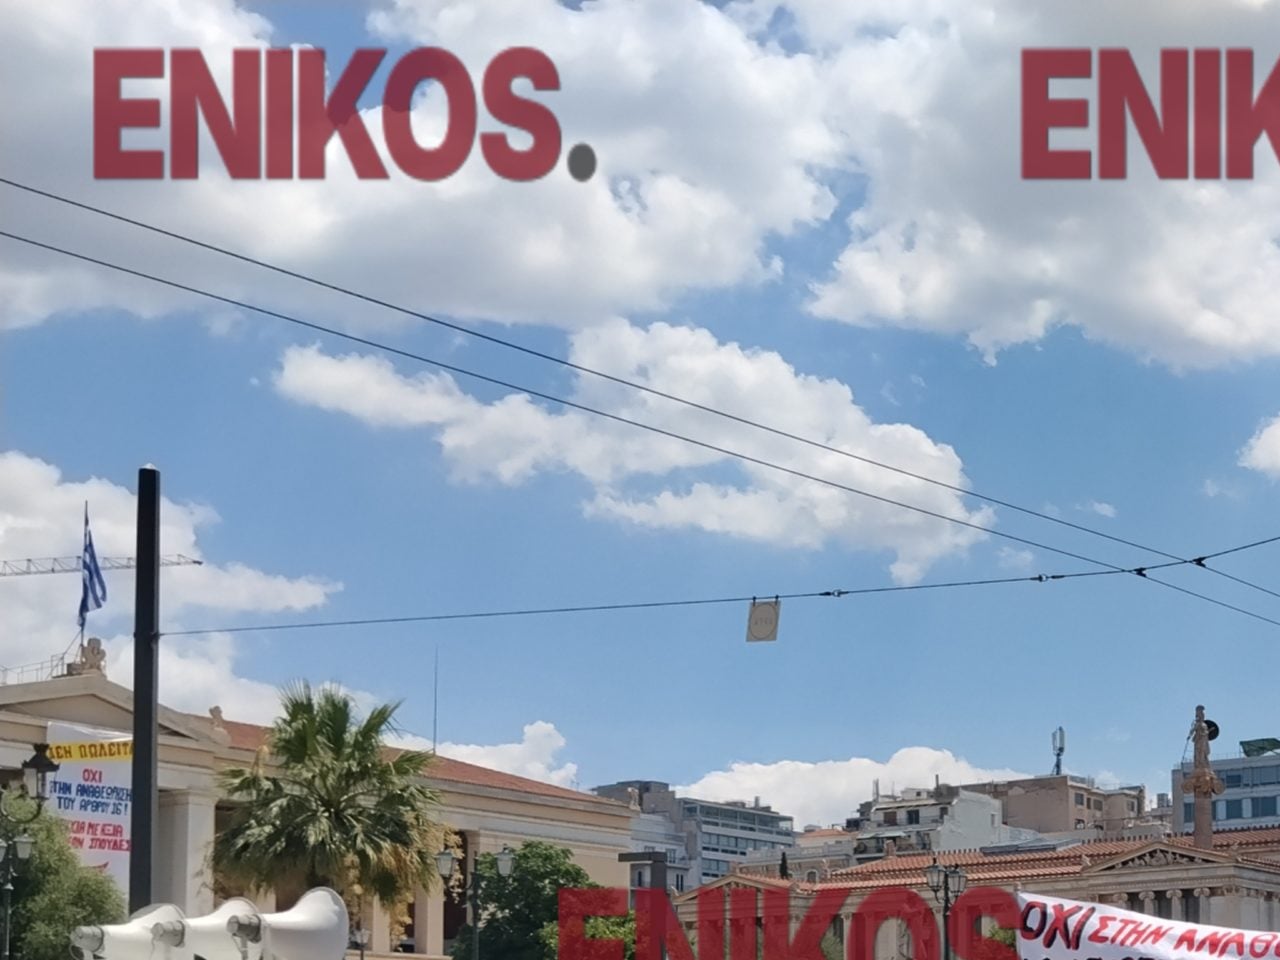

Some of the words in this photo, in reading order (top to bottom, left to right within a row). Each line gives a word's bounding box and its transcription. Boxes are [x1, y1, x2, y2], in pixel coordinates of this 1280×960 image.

[82, 769, 102, 782] ΟΧΙ
[56, 796, 76, 810] ΤΟΥ
[1020, 901, 1096, 950] ΟΧΙ
[1087, 915, 1174, 948] ΣΤΗΝ
